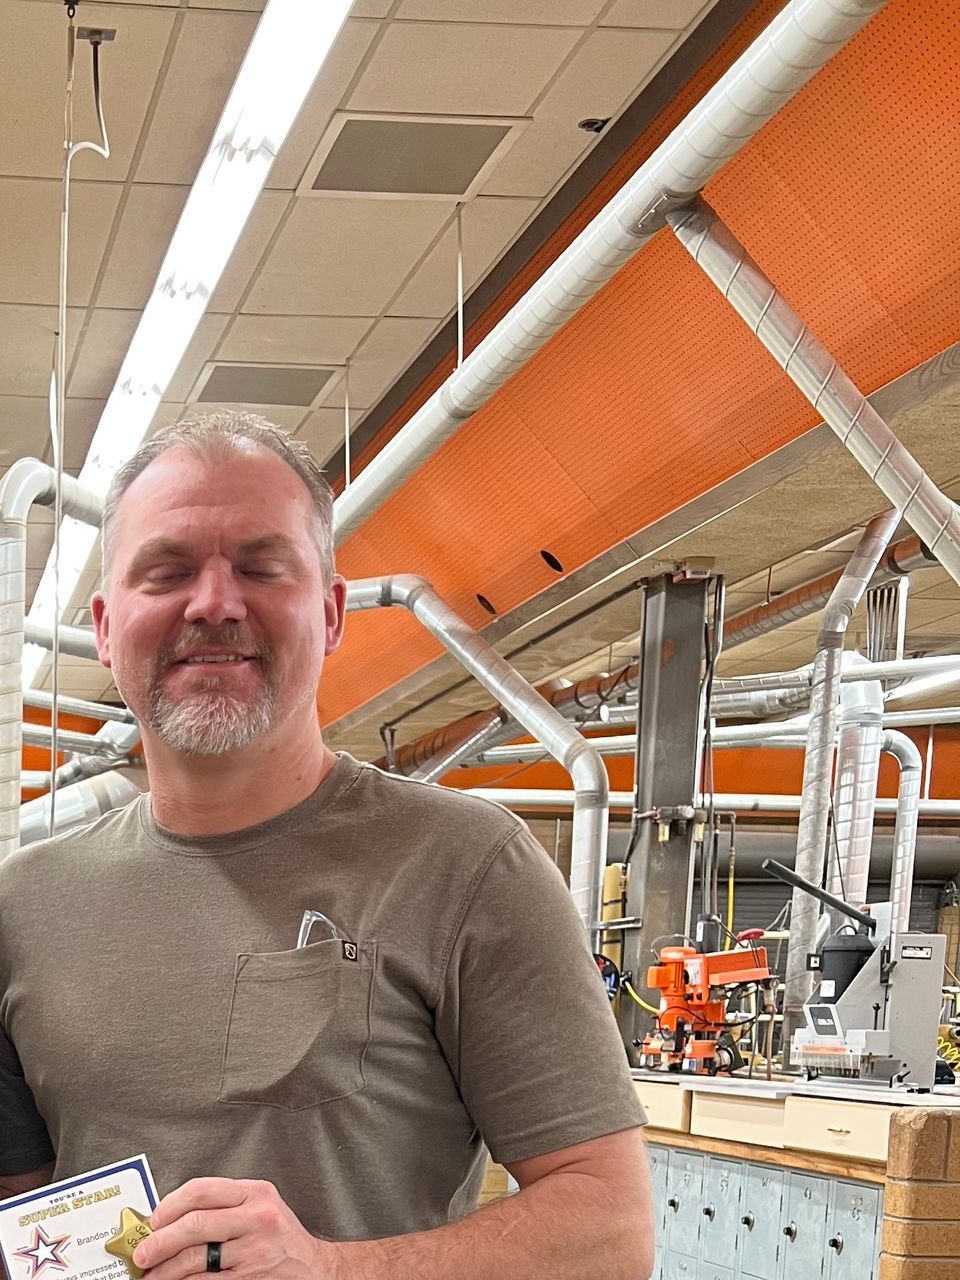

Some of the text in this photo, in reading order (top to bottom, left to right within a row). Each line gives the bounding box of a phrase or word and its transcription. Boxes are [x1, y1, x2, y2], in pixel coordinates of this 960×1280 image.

[18, 1185, 121, 1227] SUPER STAR!
[852, 1206, 862, 1221] 65
[76, 1230, 110, 1246] Brandon
[79, 1260, 117, 1279] impressed
